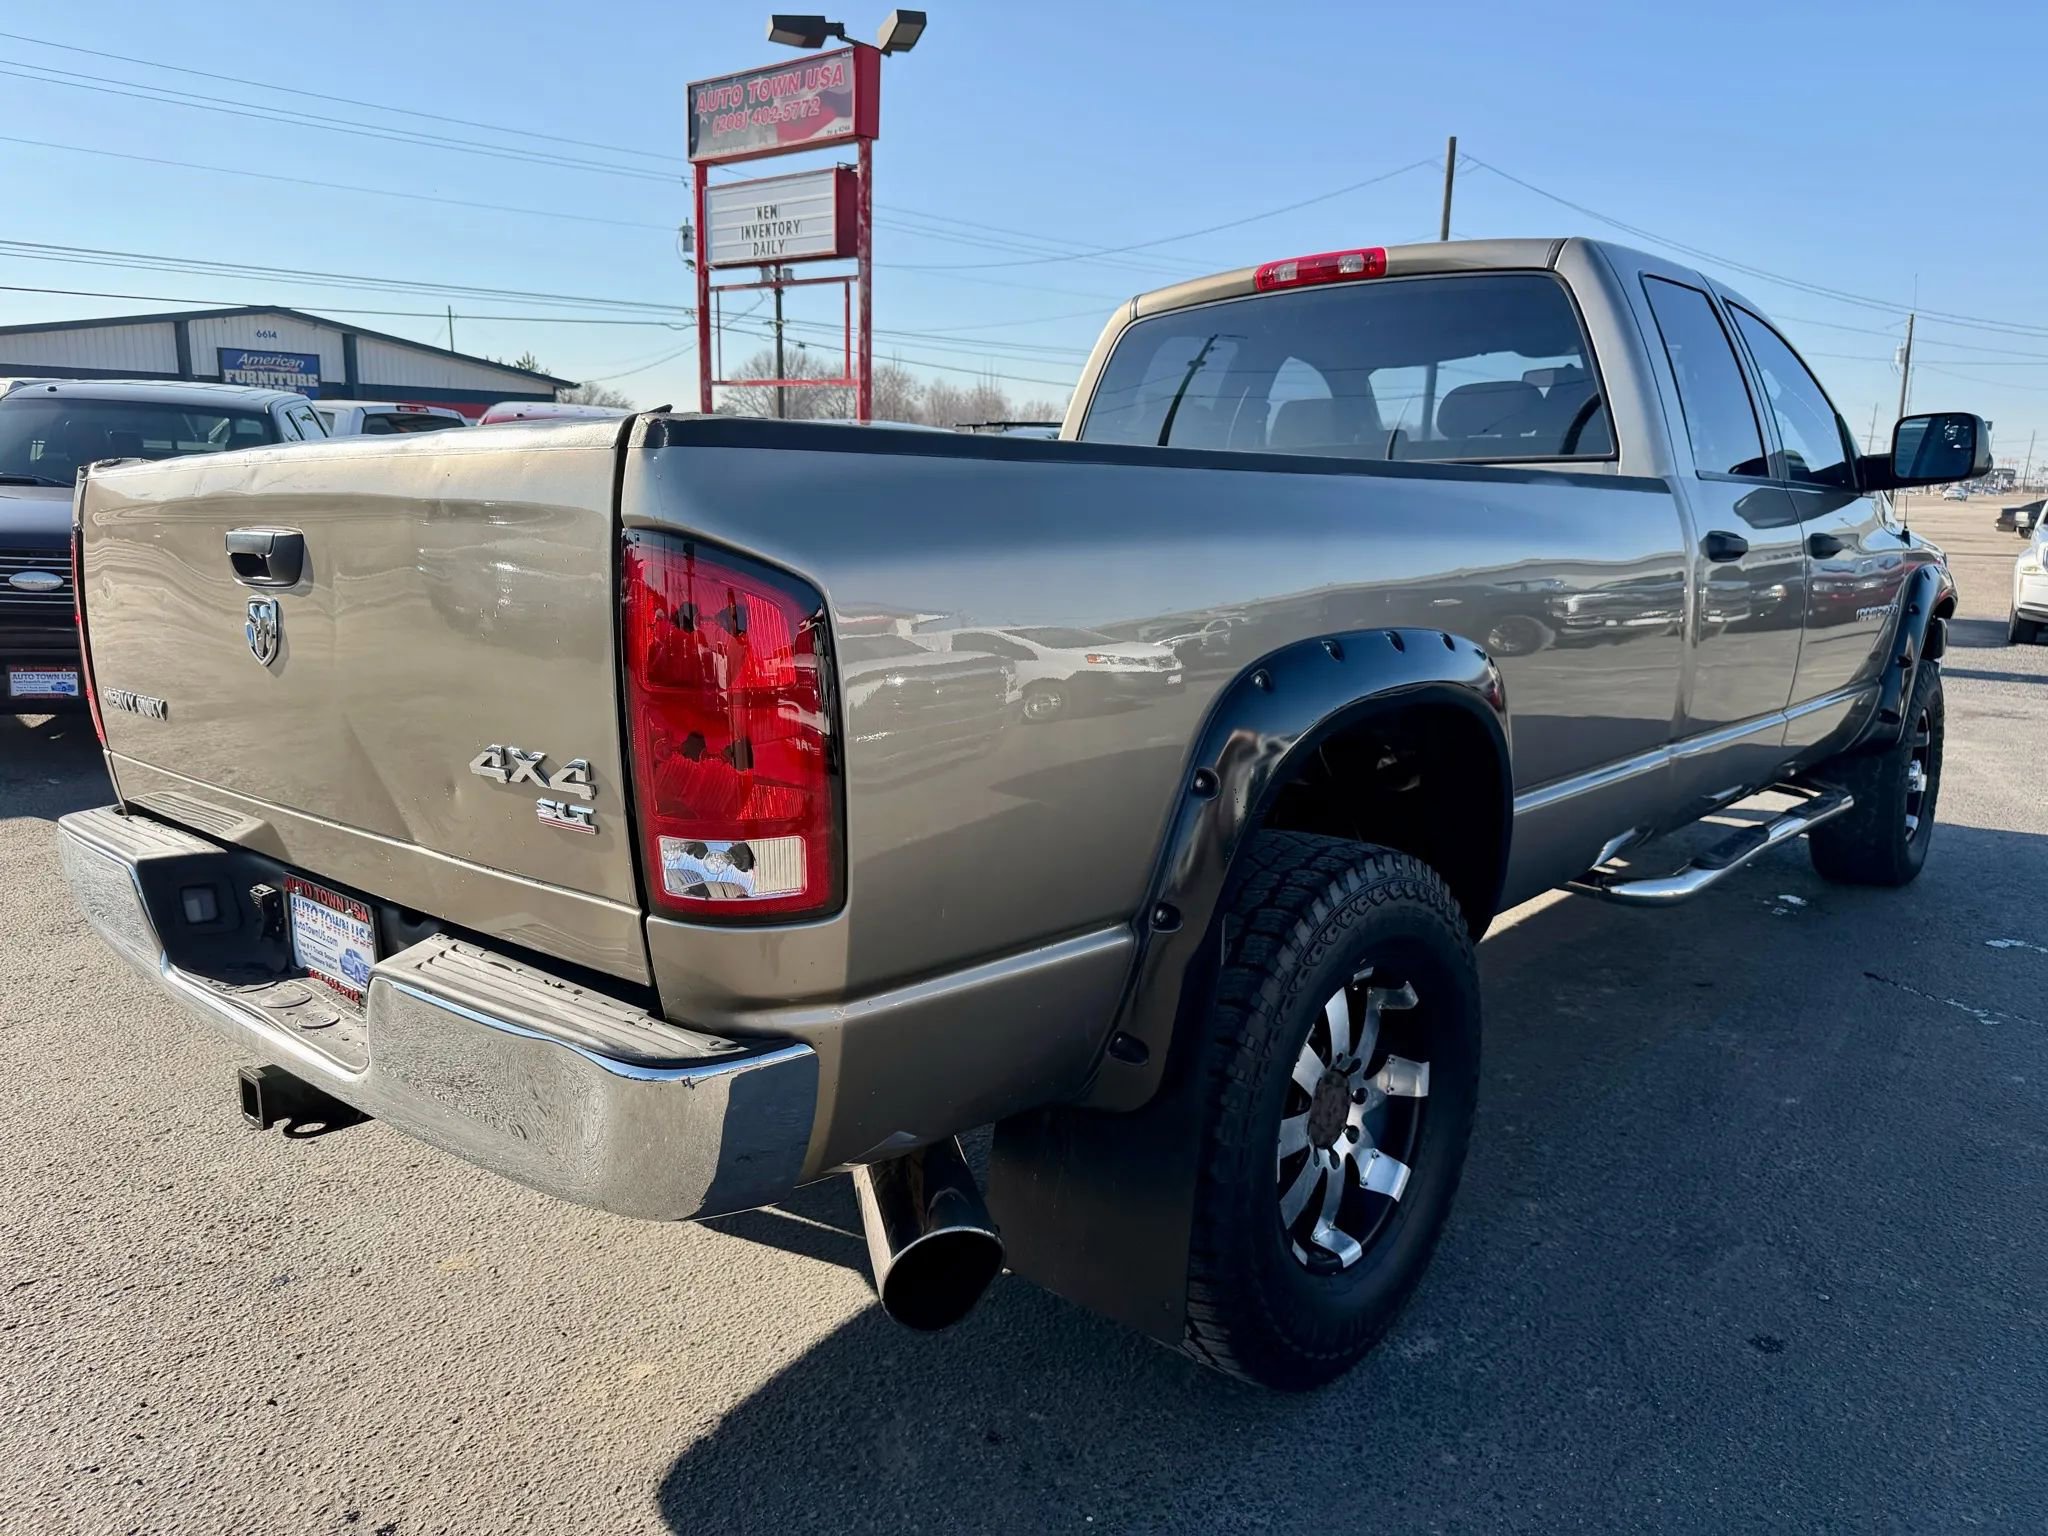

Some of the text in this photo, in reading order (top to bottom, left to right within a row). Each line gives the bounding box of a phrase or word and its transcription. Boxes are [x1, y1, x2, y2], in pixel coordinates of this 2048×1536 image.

[695, 63, 845, 114] AUTO TOWN USA
[712, 96, 822, 138] (208) 402-5772
[756, 205, 777, 220] NEW
[741, 220, 800, 241] INVENTORY
[753, 240, 785, 256] DAILY
[256, 330, 278, 339] 6614
[236, 353, 305, 369] American
[223, 369, 320, 388] FURNITURE
[469, 744, 597, 800] 4X4
[536, 798, 598, 830] SLT
[284, 876, 369, 923] AUTO TOWN USA
[292, 896, 375, 949] AUTO TOWN USA
